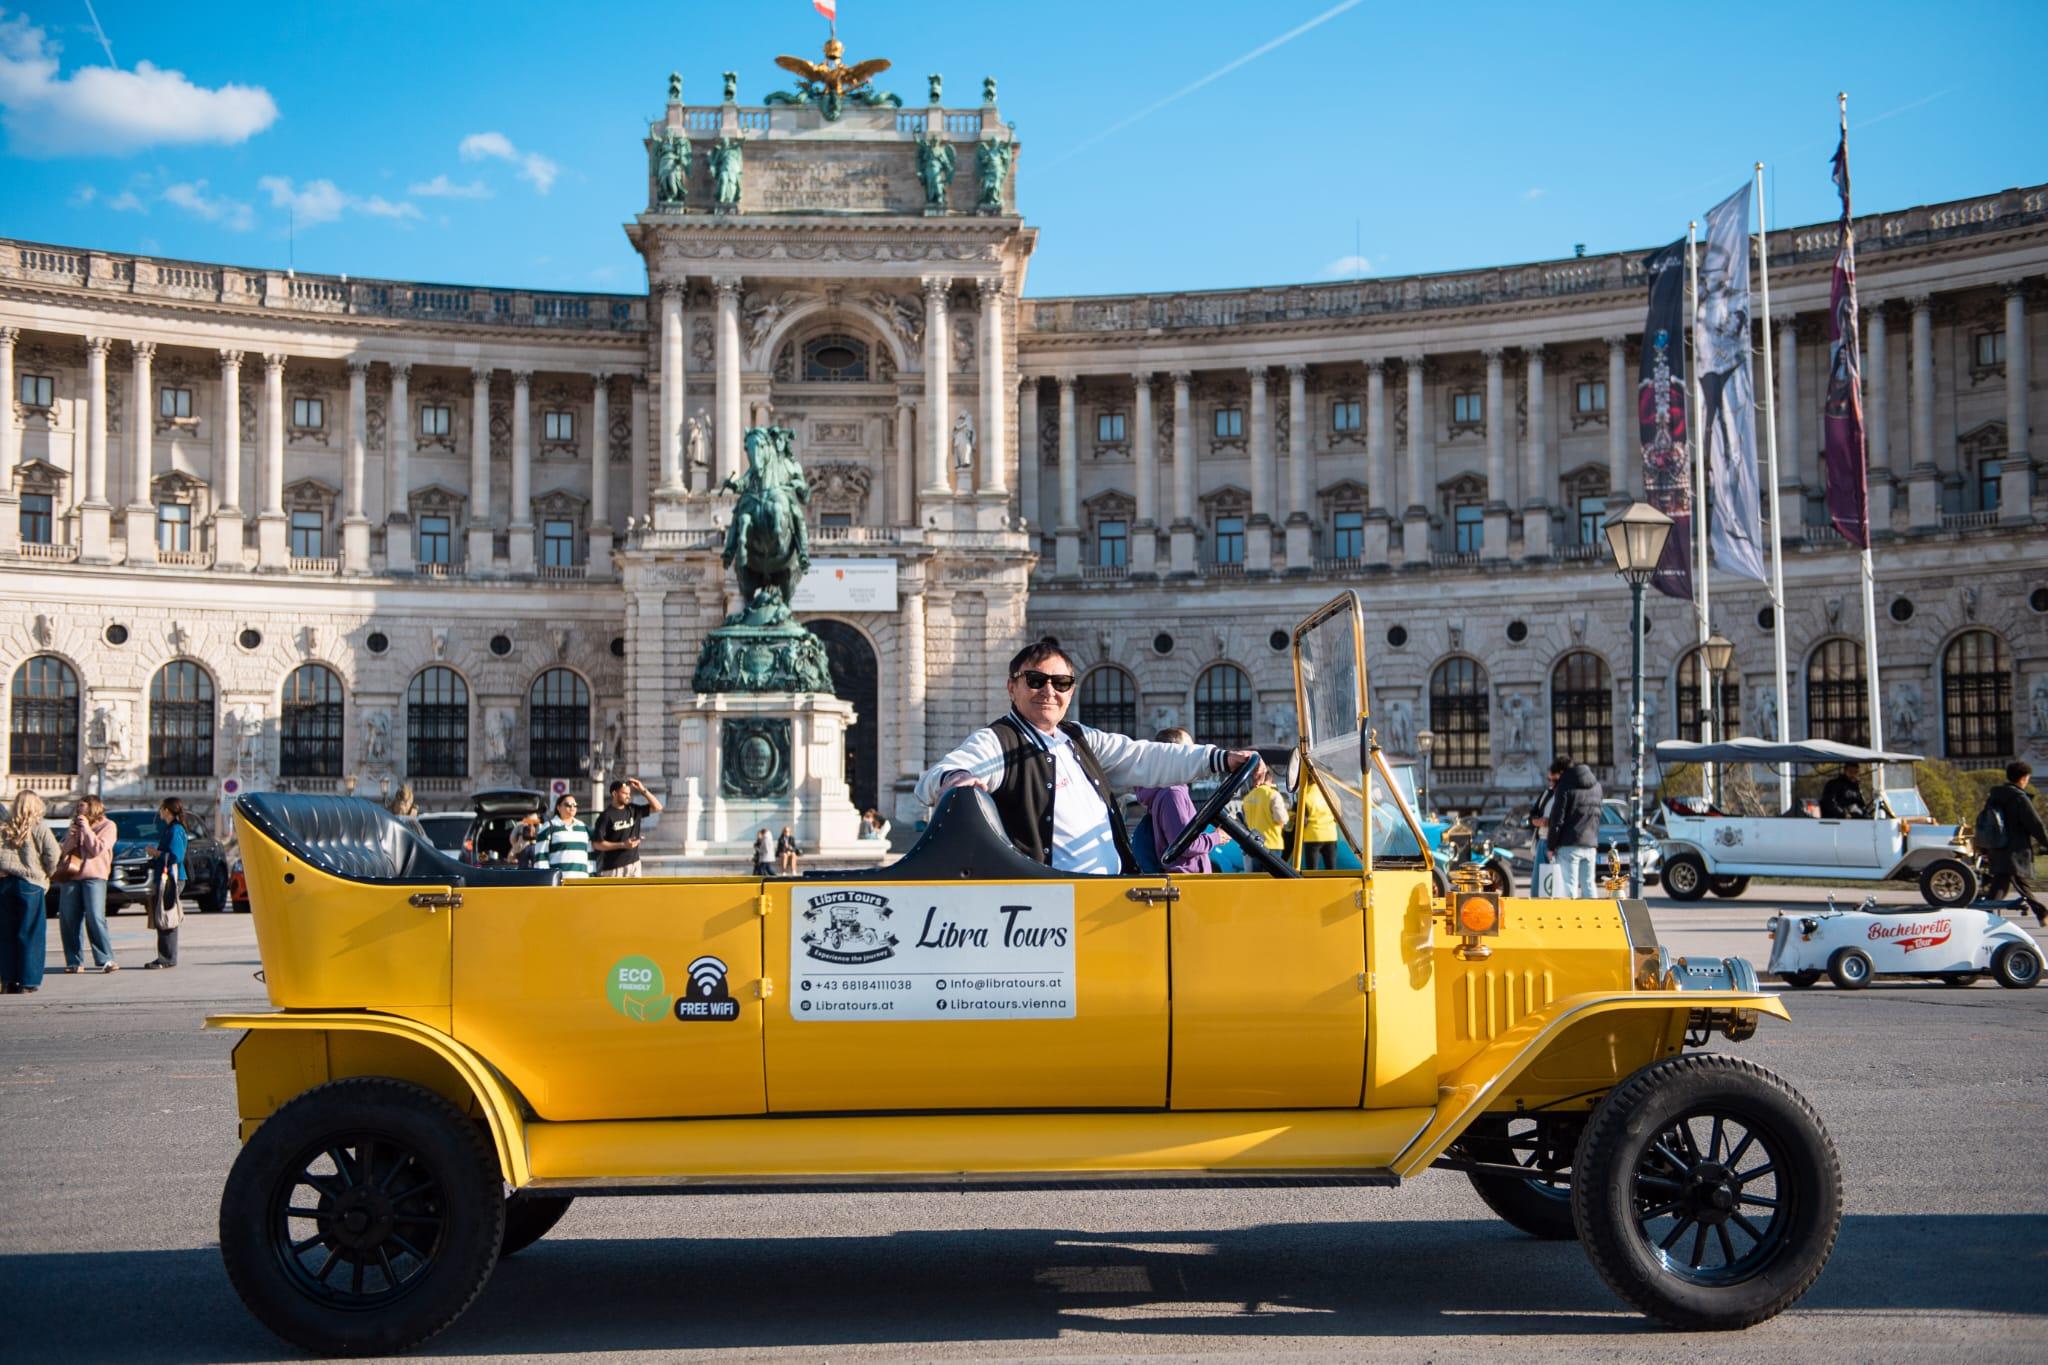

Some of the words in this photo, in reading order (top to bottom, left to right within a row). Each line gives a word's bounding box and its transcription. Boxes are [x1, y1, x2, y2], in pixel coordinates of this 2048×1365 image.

[814, 893, 845, 906] Libra
[848, 892, 881, 905] Tours
[915, 906, 988, 948] Libra
[999, 905, 1067, 948] Tours
[1868, 919, 1951, 940] Bachelorette
[619, 968, 652, 982] ECO
[619, 983, 651, 991] FRIENDLY
[815, 980, 838, 990] +43
[842, 980, 912, 990] 68184111038
[680, 1003, 708, 1015] FREE
[709, 1003, 734, 1015] WiFi
[816, 1000, 894, 1011] Libratours.at
[951, 998, 1066, 1010] Libratours.vienna
